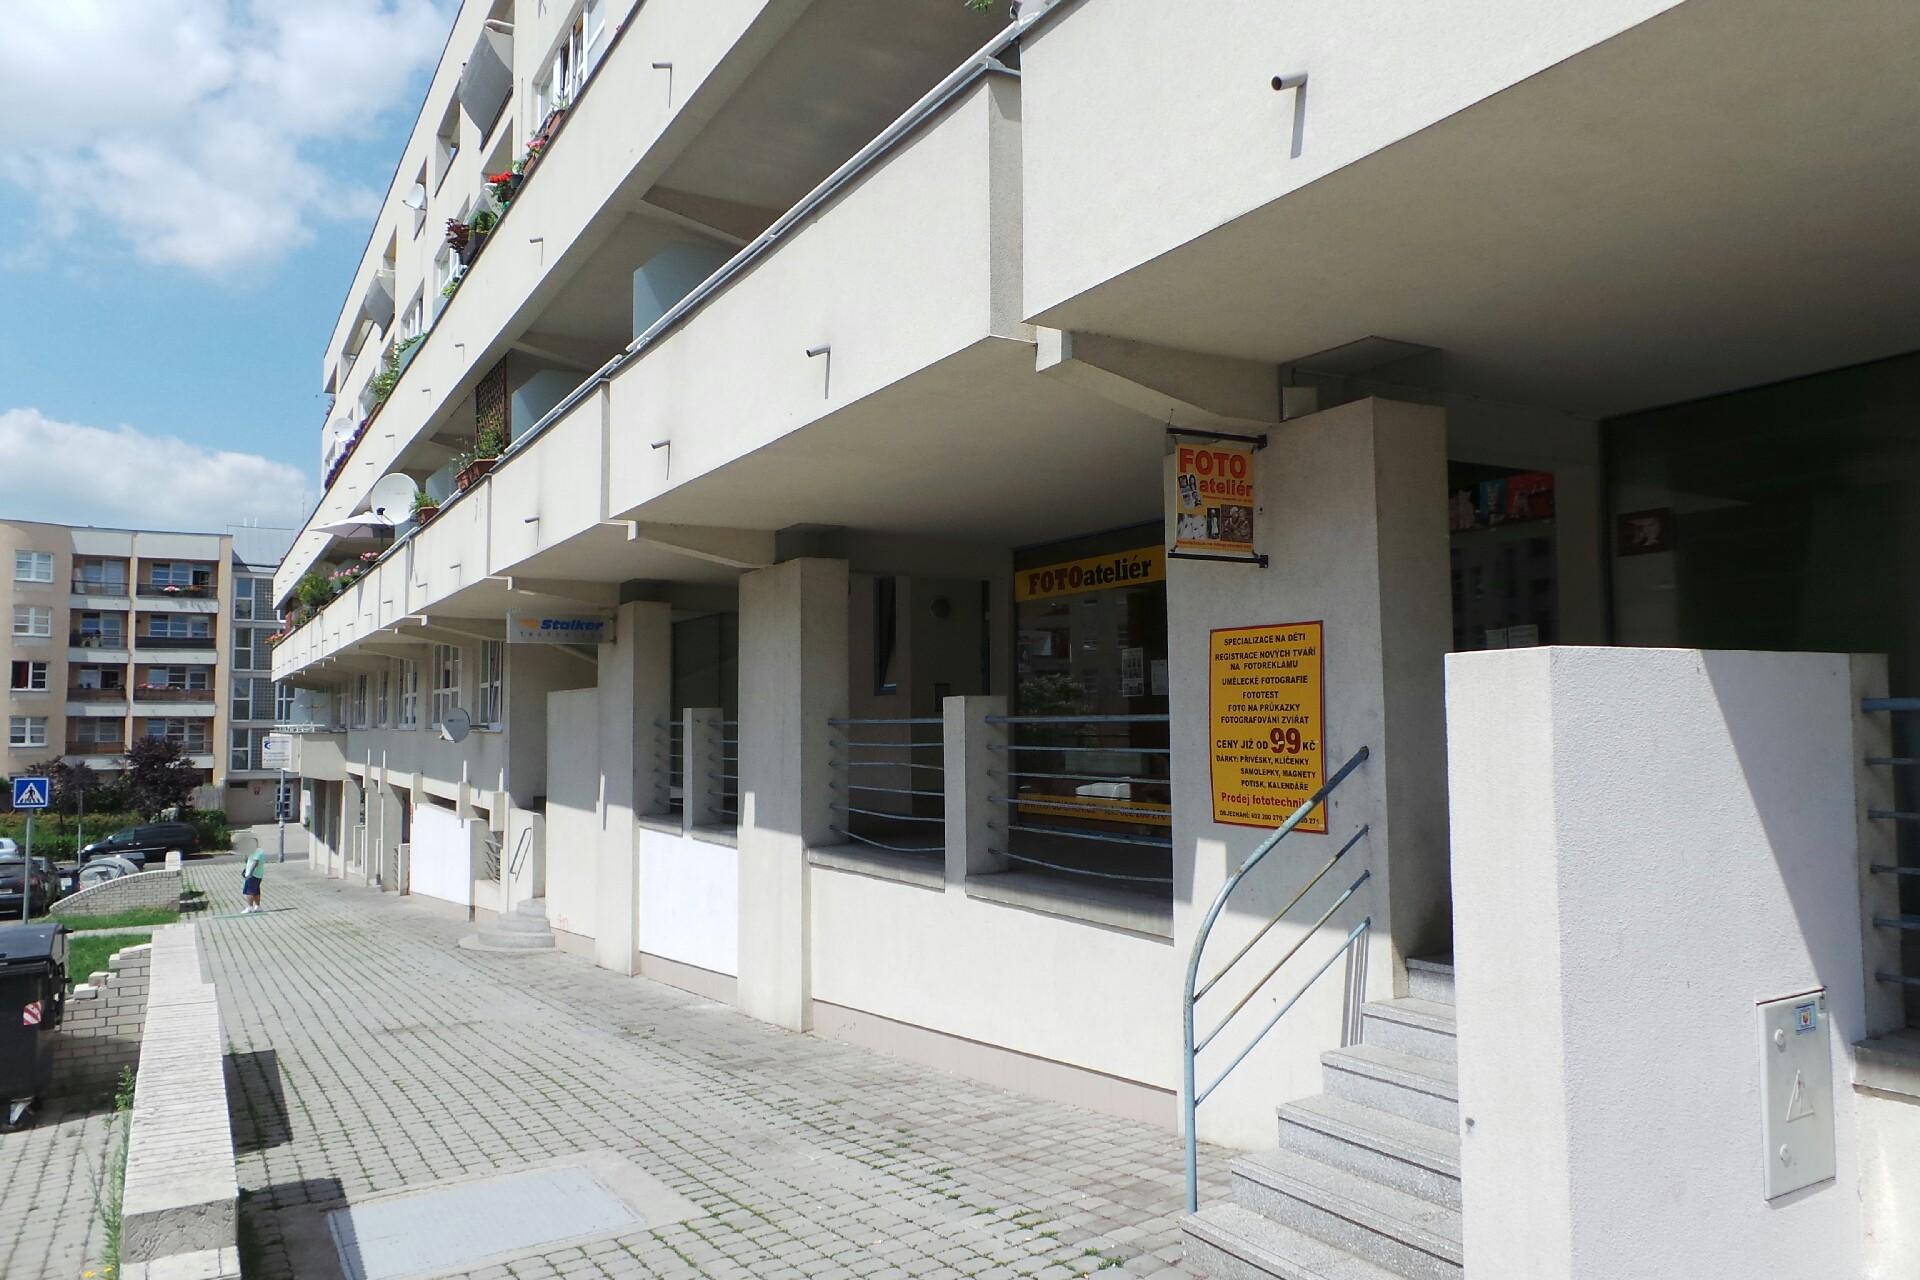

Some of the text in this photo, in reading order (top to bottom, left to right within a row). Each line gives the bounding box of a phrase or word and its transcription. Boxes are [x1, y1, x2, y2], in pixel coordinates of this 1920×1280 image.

[1180, 448, 1246, 478] FOTO
[1199, 478, 1253, 497] ateliér
[540, 619, 604, 631] Stalker
[1224, 632, 1306, 646] SPECIALIZACE NA DĚTI
[1215, 652, 1258, 661] REGISTRACE
[1259, 648, 1290, 658] NOVÝCH
[1243, 660, 1298, 670] FOTOREKLAMU
[1261, 675, 1308, 684] FOTOGRAFIE
[1242, 691, 1279, 699] FOTOTEST
[1228, 704, 1246, 712] FOTO
[1260, 702, 1301, 712] PRŮKAZKY
[1220, 714, 1279, 724] FOTOGRAFOVÁNÍ
[1216, 728, 1316, 754] CENY JIŽ OD 99 KČ
[1240, 768, 1316, 779] SAMOLEPKY, MAGNETY
[1221, 792, 1305, 808] Prodej fototechni
